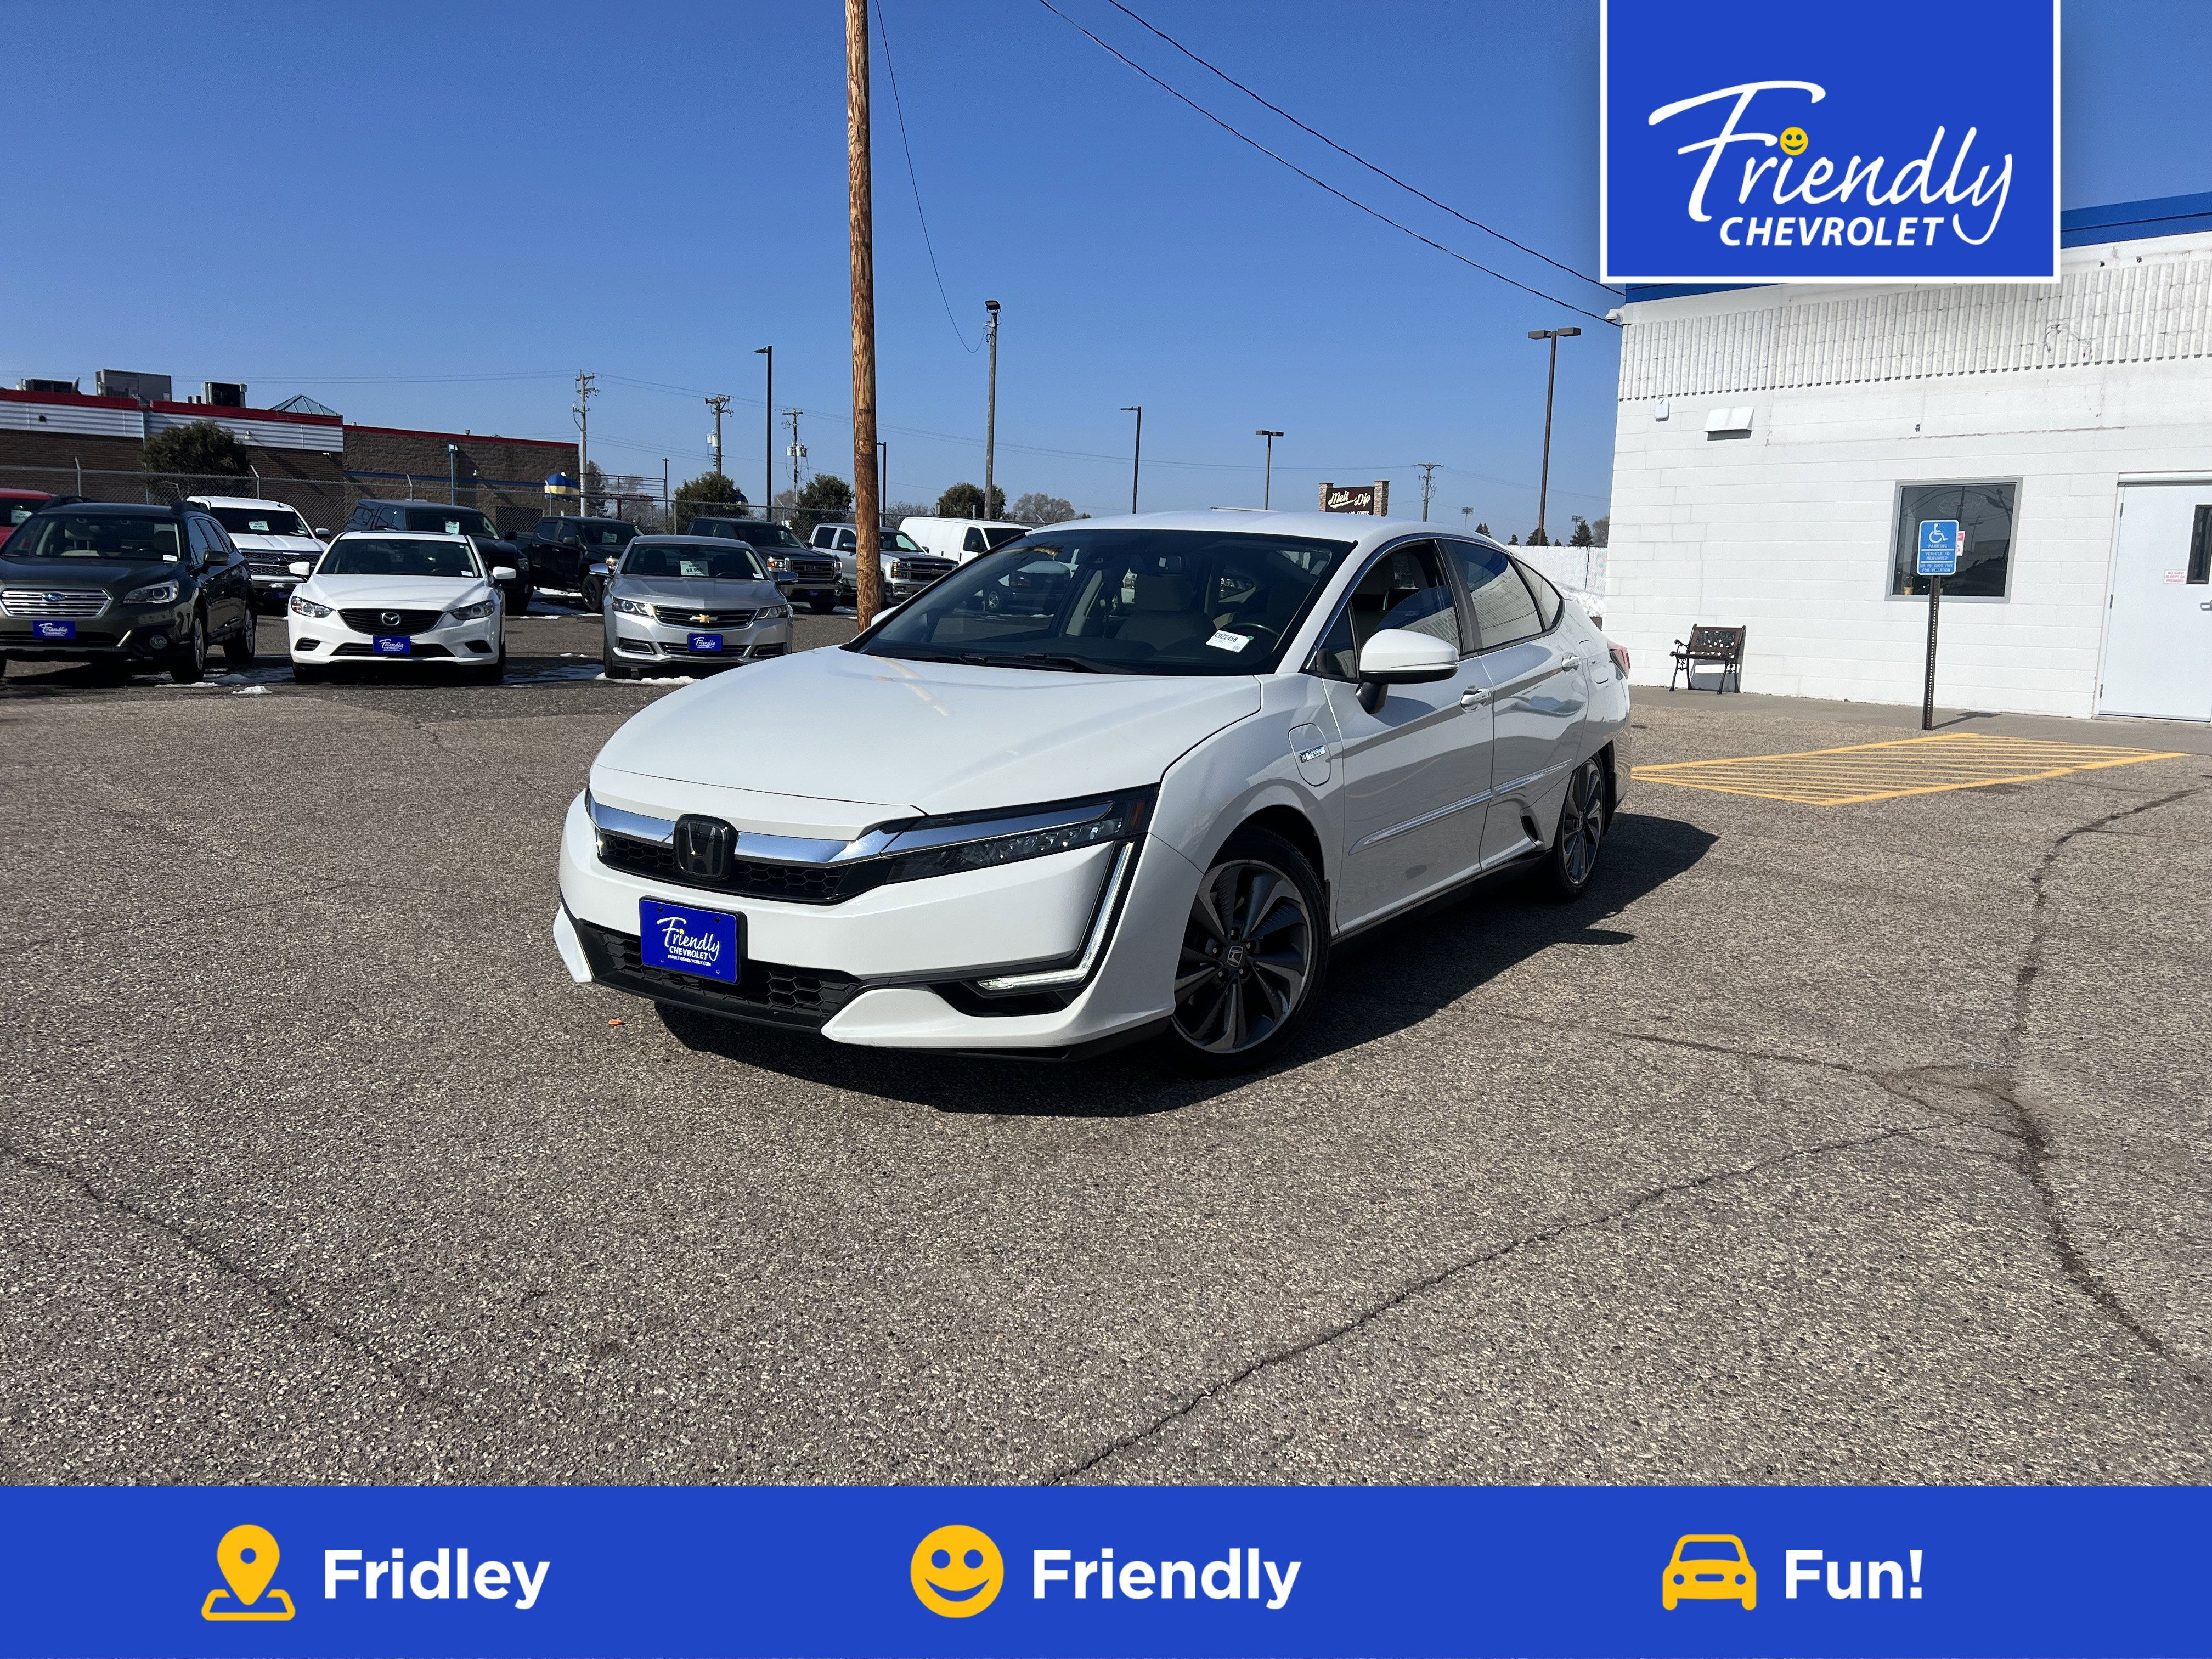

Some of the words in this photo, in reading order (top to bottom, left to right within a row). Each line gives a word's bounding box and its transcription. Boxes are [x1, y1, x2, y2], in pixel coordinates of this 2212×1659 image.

[1328, 490, 1350, 505] Melt
[1354, 492, 1370, 507] Dip
[379, 639, 404, 650] Friendly
[693, 637, 716, 647] Friendly
[657, 917, 720, 962] Friendly
[669, 946, 709, 960] CHEVROLET
[667, 954, 712, 967] WWW.FRIENDLYCHEV.COM
